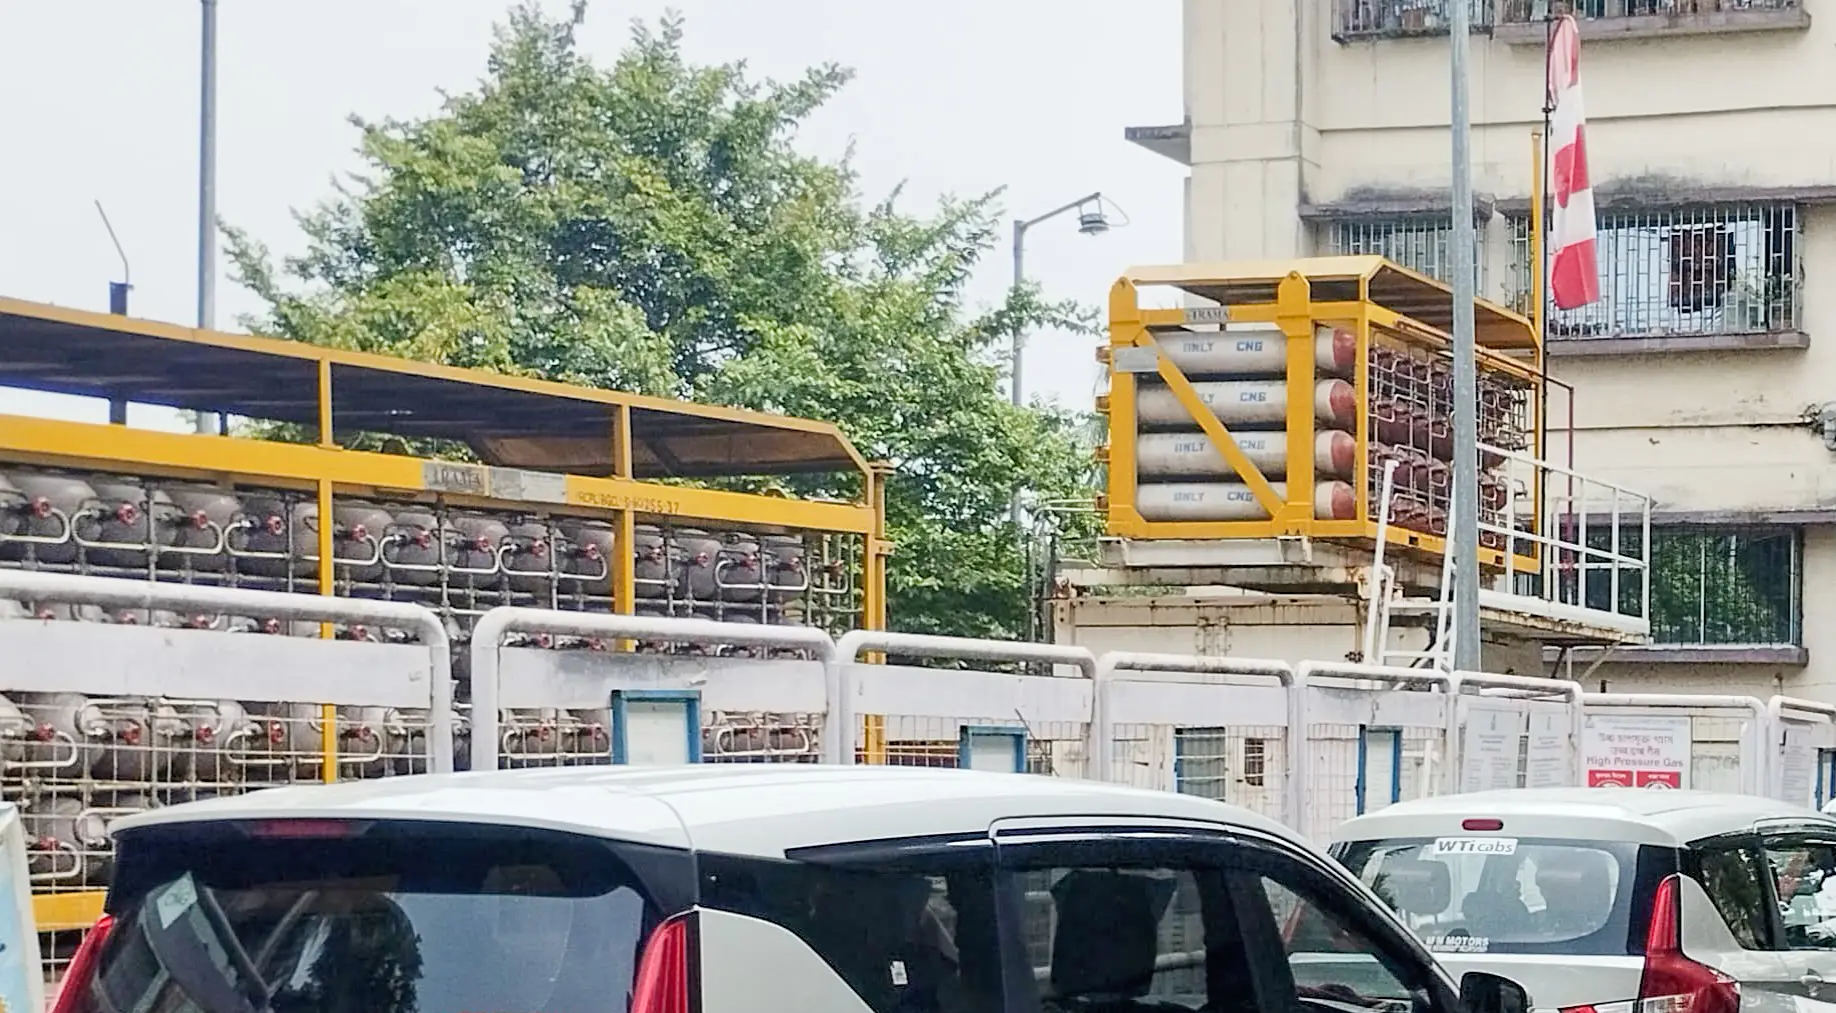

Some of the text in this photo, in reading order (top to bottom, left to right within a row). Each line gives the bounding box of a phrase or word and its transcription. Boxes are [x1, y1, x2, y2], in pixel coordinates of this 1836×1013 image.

[1236, 341, 1263, 352] CNG
[1240, 391, 1267, 402] CNG
[1174, 440, 1266, 452] ONLY CNG
[1227, 491, 1255, 502] CNG
[1586, 756, 1684, 768] High Pressure Gas
[1446, 935, 1489, 946] MOTORS
